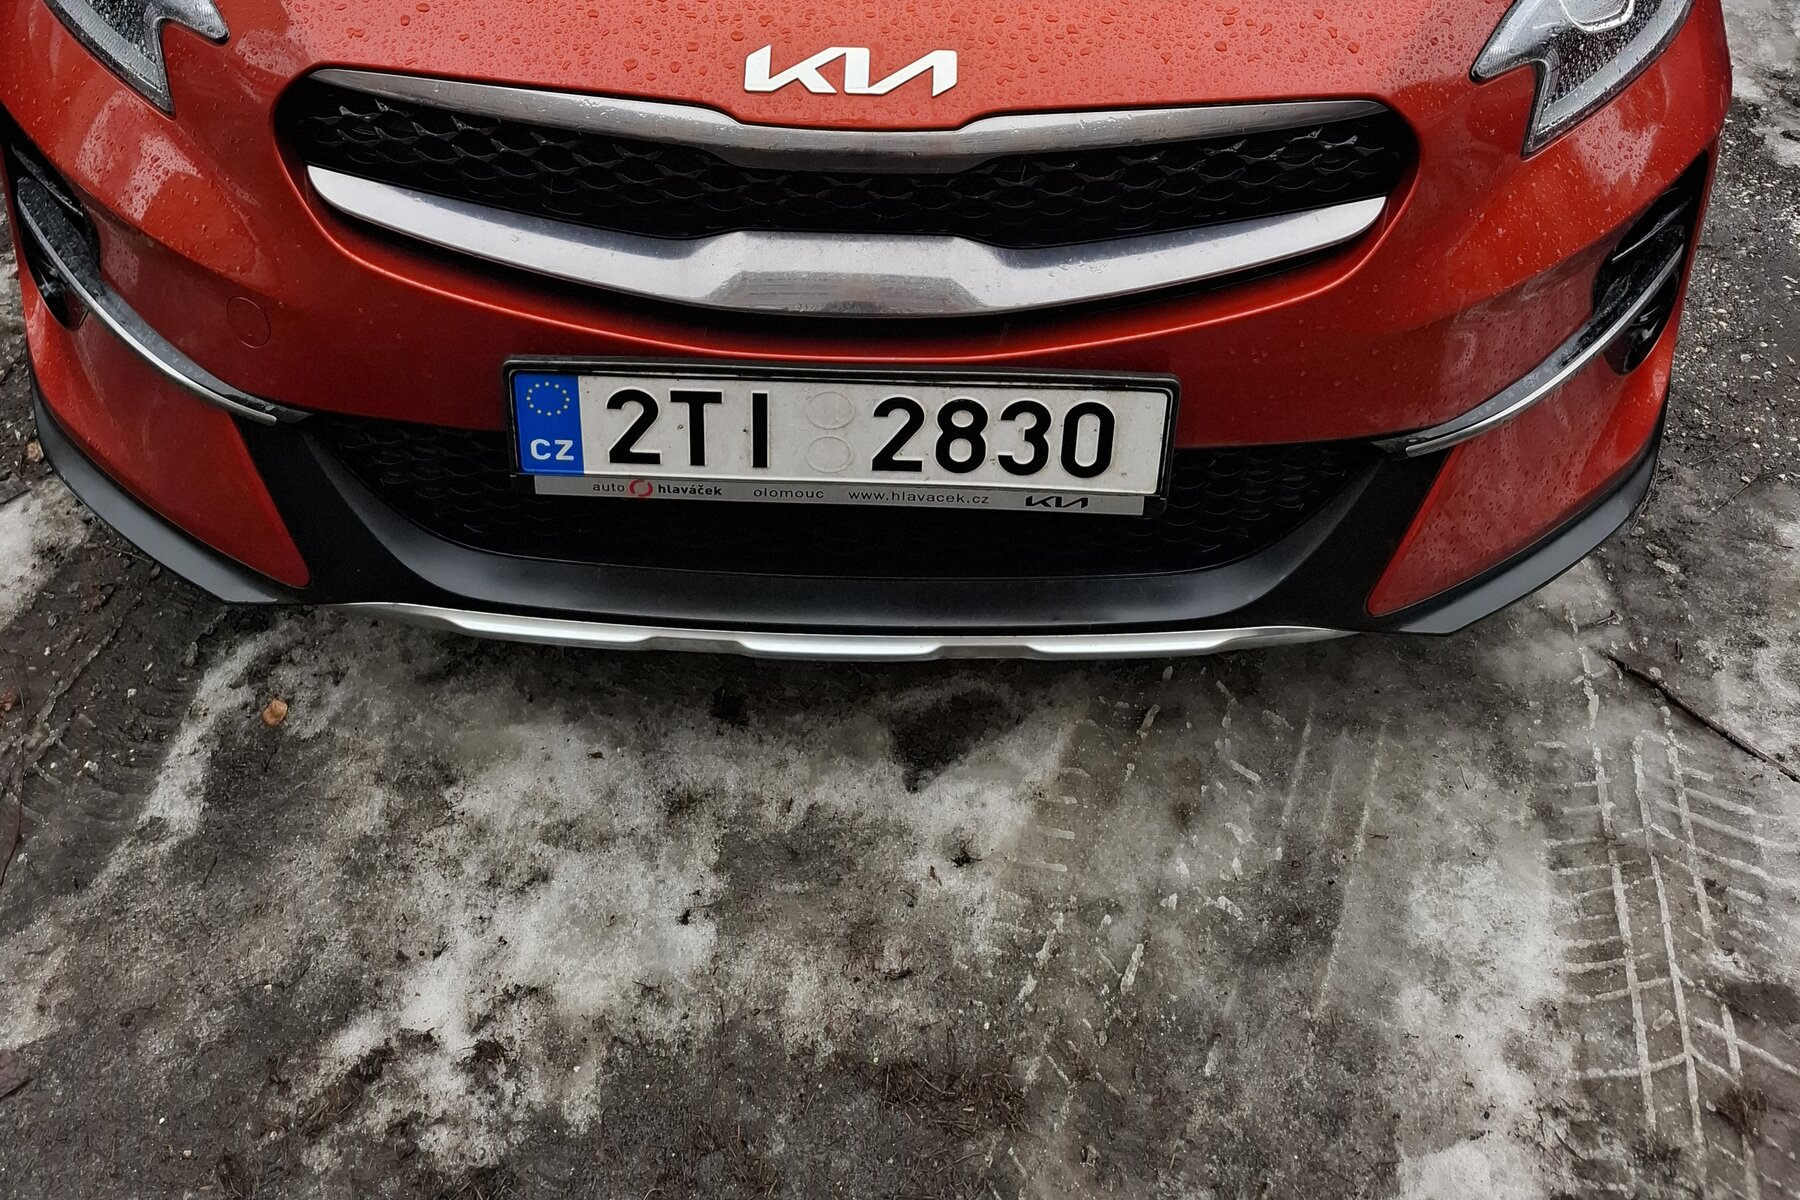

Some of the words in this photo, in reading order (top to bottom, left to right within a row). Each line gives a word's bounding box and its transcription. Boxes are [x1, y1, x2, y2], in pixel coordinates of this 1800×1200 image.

[744, 44, 957, 98] KIA
[530, 437, 575, 463] CZ
[605, 388, 770, 469] 2TI
[871, 396, 1116, 479] 2830
[592, 481, 625, 493] auto
[657, 483, 723, 496] hlaváček
[752, 487, 825, 499] olomouc
[848, 490, 990, 505] www.hlavacek.cz
[1025, 495, 1088, 509] KIA
